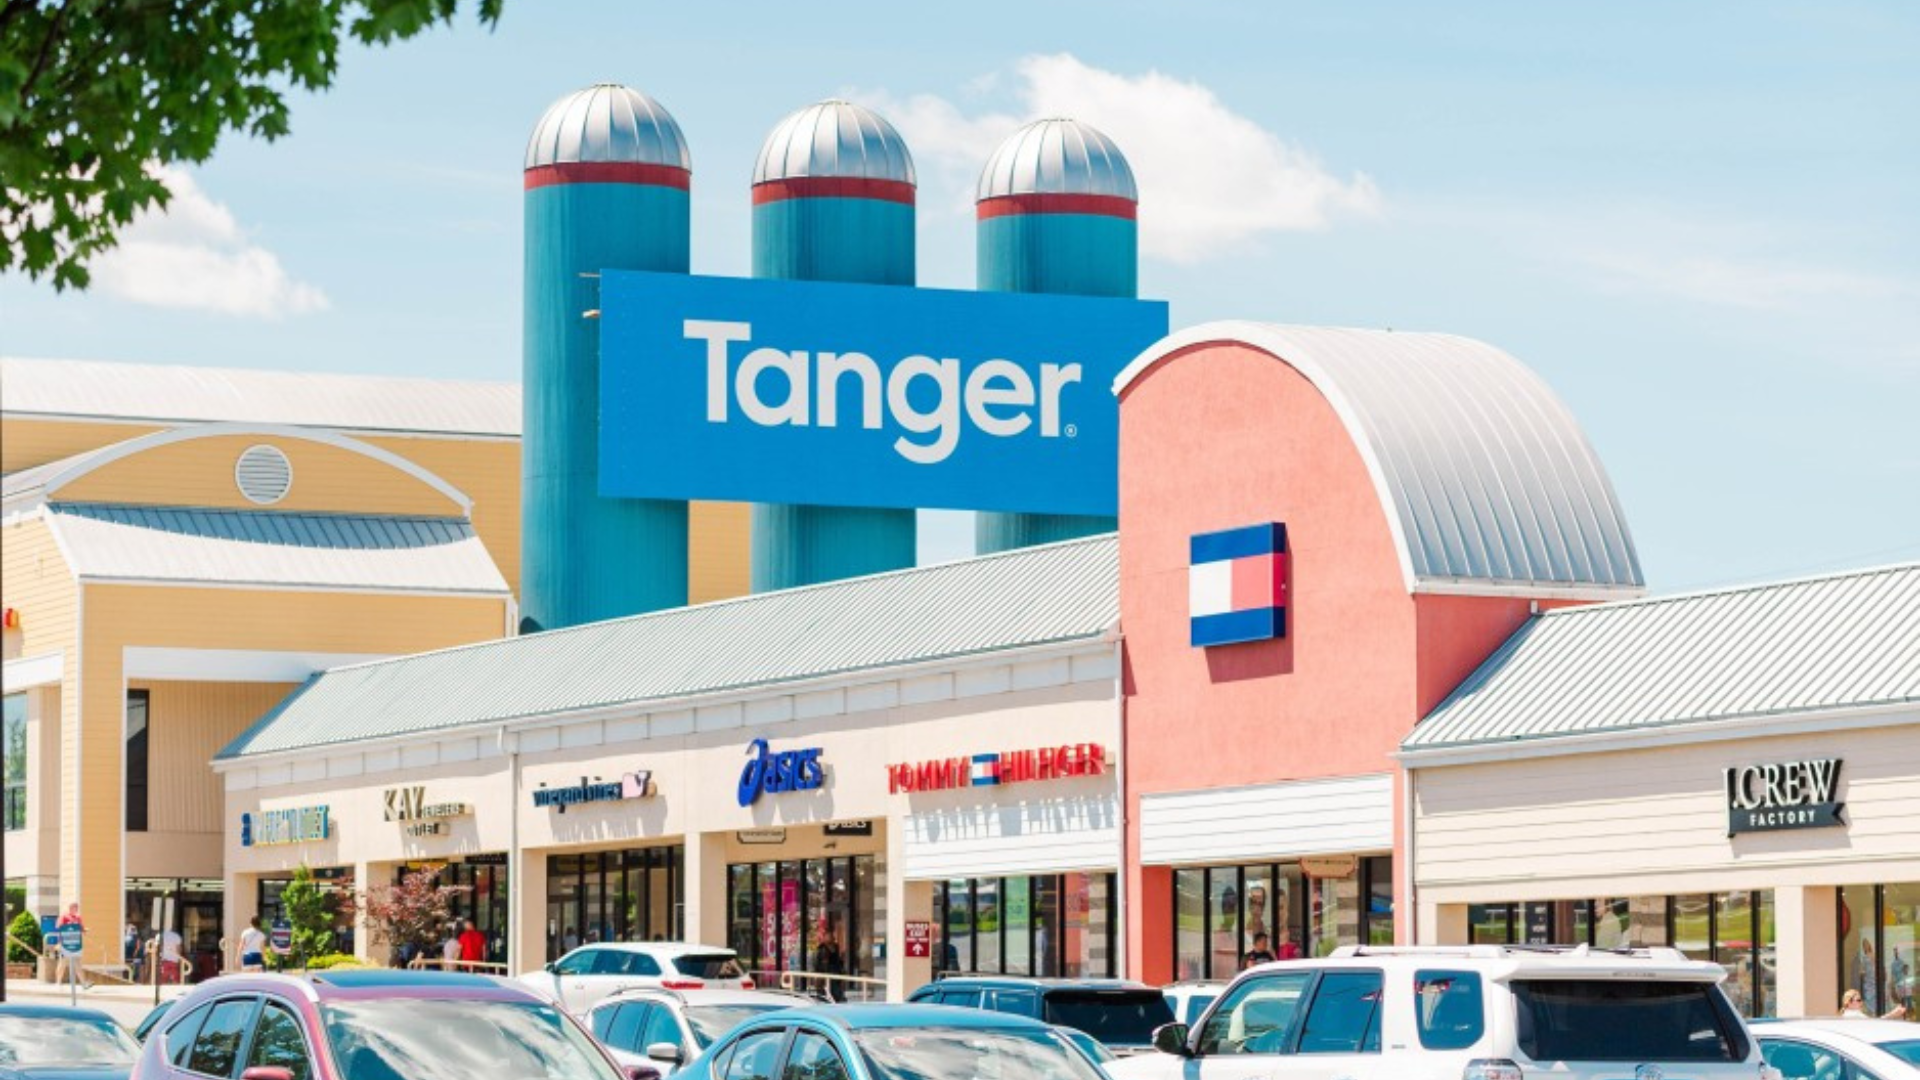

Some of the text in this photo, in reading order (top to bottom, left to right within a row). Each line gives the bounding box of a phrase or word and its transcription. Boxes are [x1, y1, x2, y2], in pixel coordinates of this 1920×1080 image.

[683, 319, 1082, 465] Tanger
[885, 743, 1106, 795] TOMMY HILFIGER
[384, 786, 425, 821] KAY
[1722, 759, 1840, 838] J.CREW
[1749, 810, 1815, 827] FACTORY
